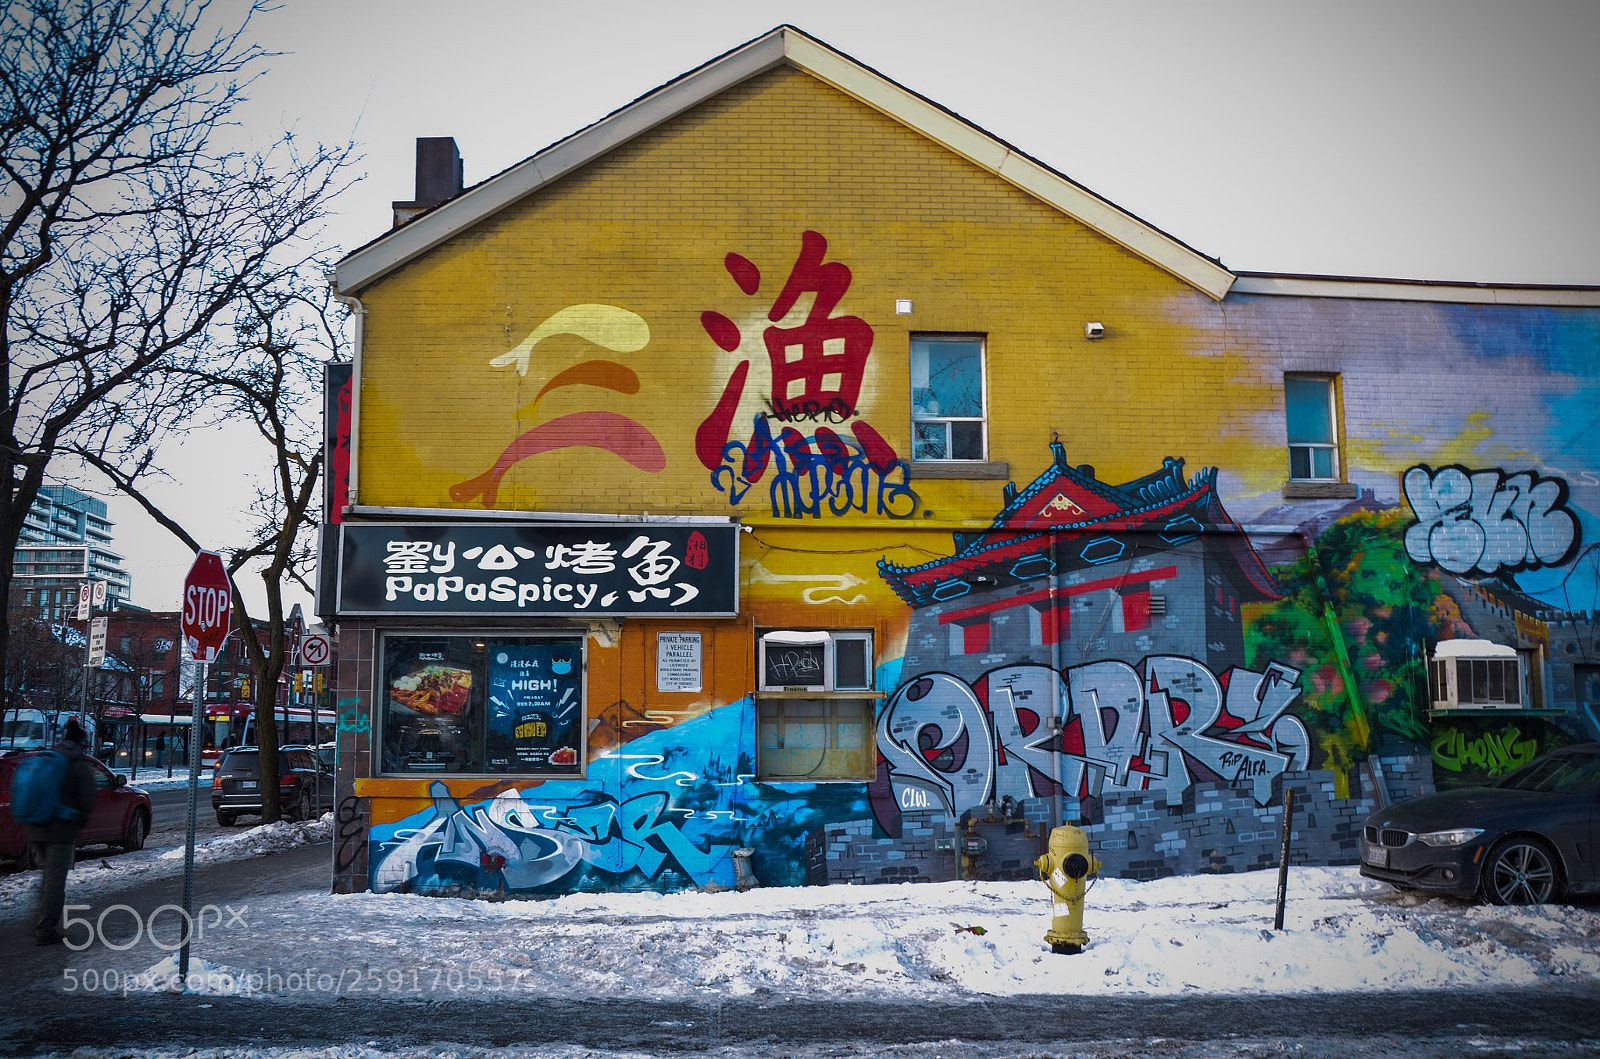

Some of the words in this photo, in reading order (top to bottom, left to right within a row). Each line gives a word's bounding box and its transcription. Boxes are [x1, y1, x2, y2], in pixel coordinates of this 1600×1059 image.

[185, 584, 229, 628] STOP
[680, 636, 700, 644] PARKING
[511, 678, 558, 693] HIGH!
